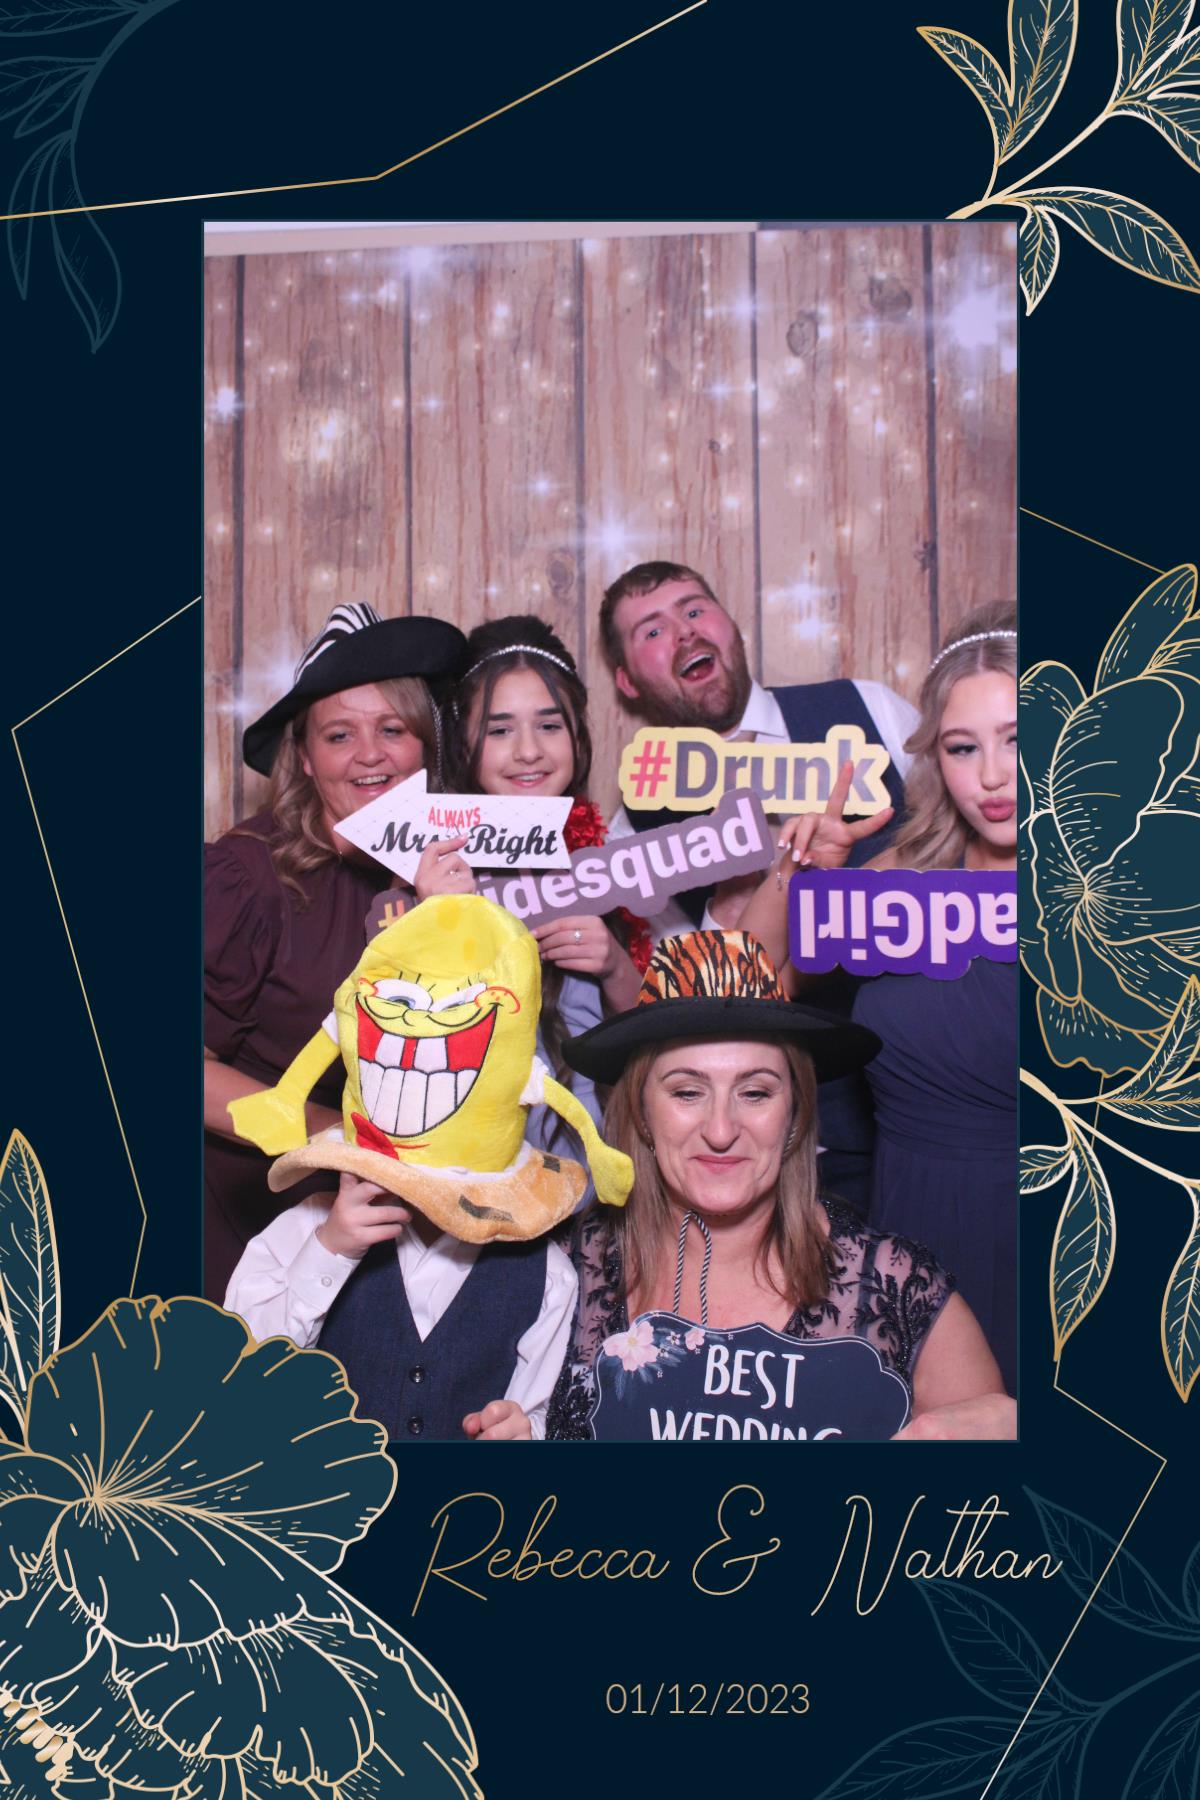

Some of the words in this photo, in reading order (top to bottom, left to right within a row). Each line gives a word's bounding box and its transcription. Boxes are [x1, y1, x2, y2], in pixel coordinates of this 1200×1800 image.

[630, 739, 877, 802] #Drunk
[428, 806, 481, 828] ALWAYS
[464, 823, 557, 865] Right
[378, 797, 764, 928] idesquad
[704, 1344, 805, 1409] BEST
